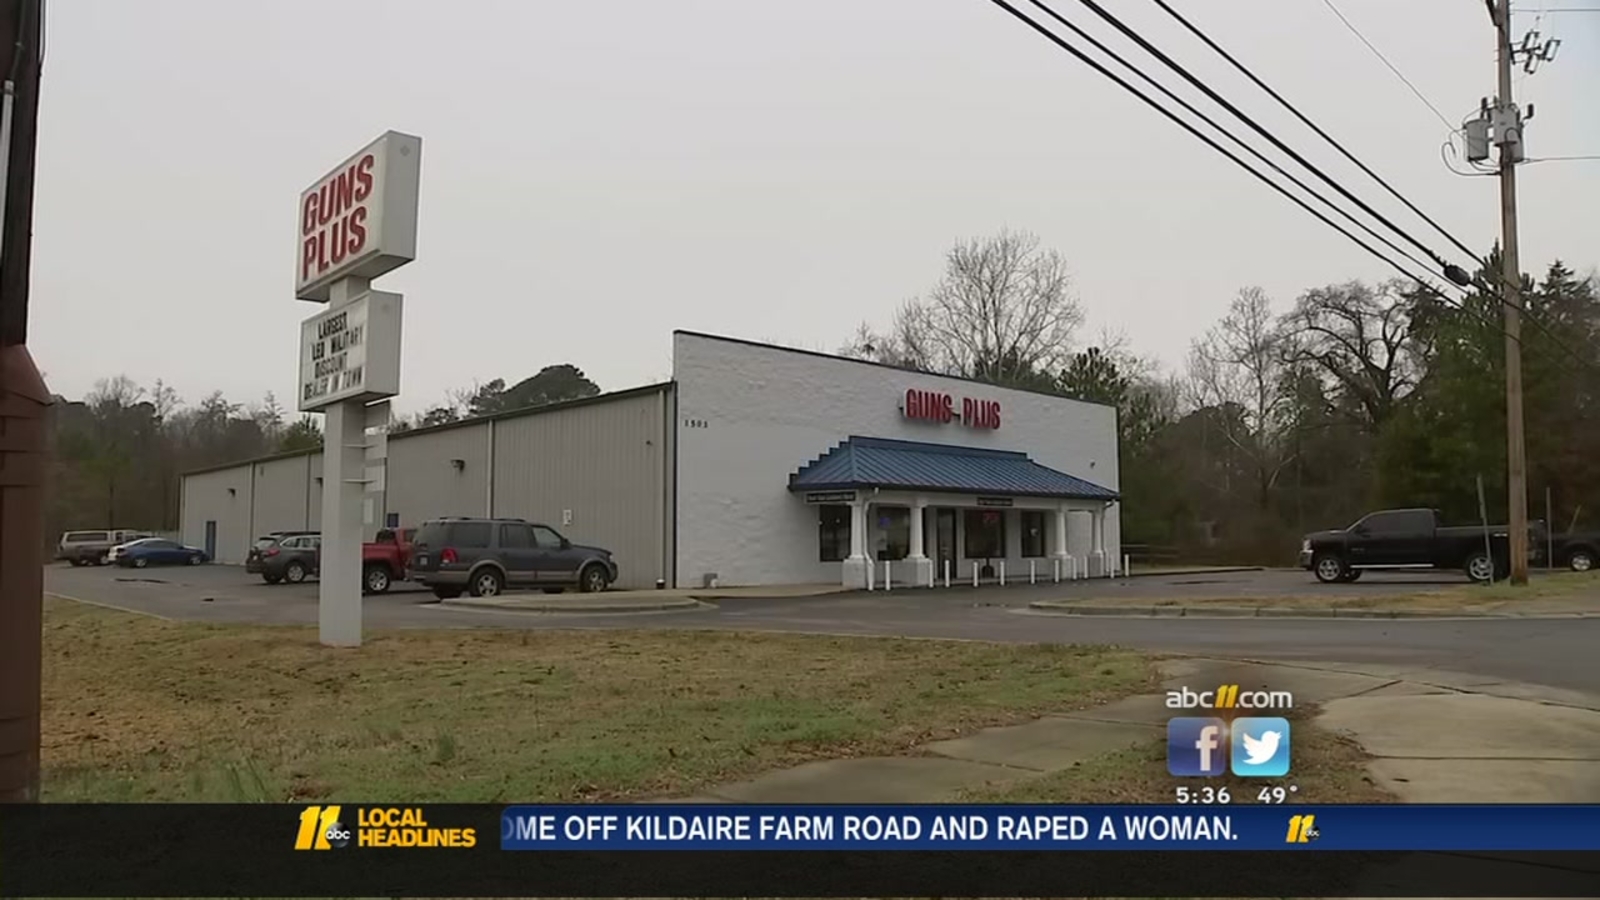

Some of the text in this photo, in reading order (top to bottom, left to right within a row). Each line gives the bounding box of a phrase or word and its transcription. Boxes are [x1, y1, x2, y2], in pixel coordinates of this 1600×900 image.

[302, 154, 375, 237] GUNS
[302, 205, 368, 283] PLUS
[318, 311, 348, 340] LARGEST
[314, 351, 348, 379] DISCOUNT
[905, 388, 1001, 430] GUNS PLUS
